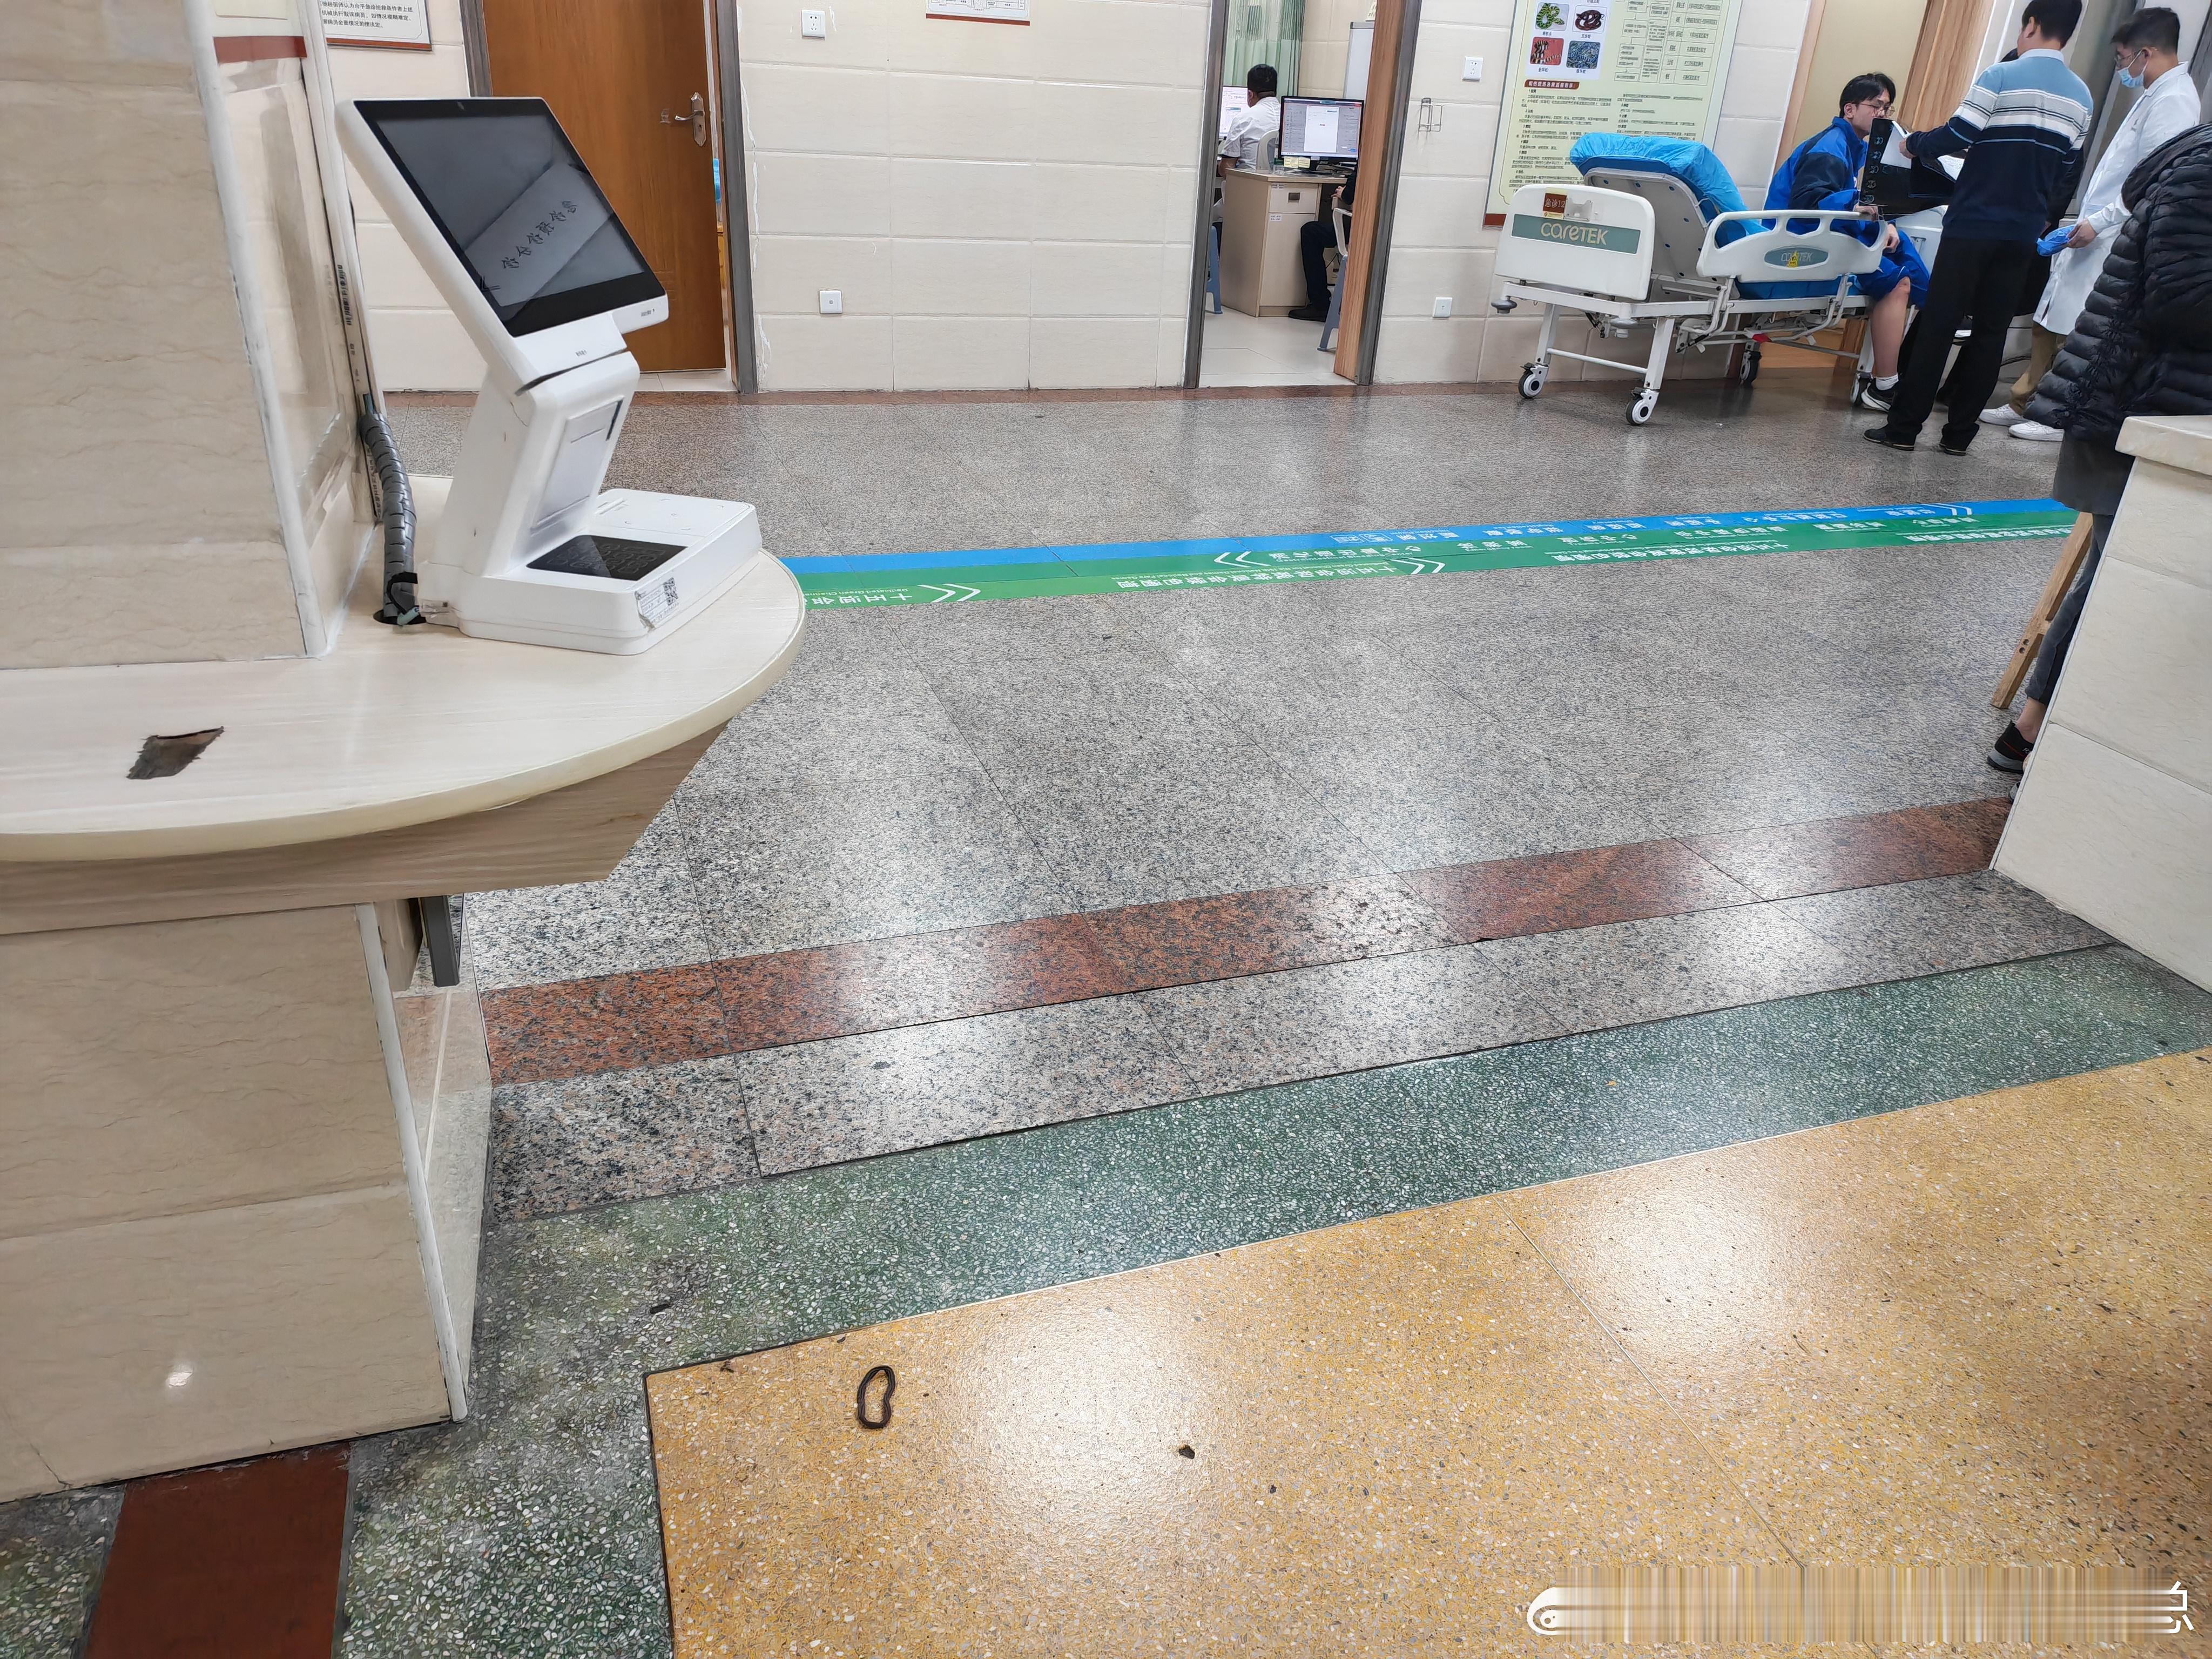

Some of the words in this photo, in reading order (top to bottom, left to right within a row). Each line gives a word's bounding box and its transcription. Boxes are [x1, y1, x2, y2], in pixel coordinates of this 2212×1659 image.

[1545, 198, 1565, 208] 急诊12
[1268, 544, 1421, 559] 消化道出血中心
[1116, 565, 1397, 589] 十五运会和残特奥会绿色通道
[804, 592, 912, 605] 十五运会
